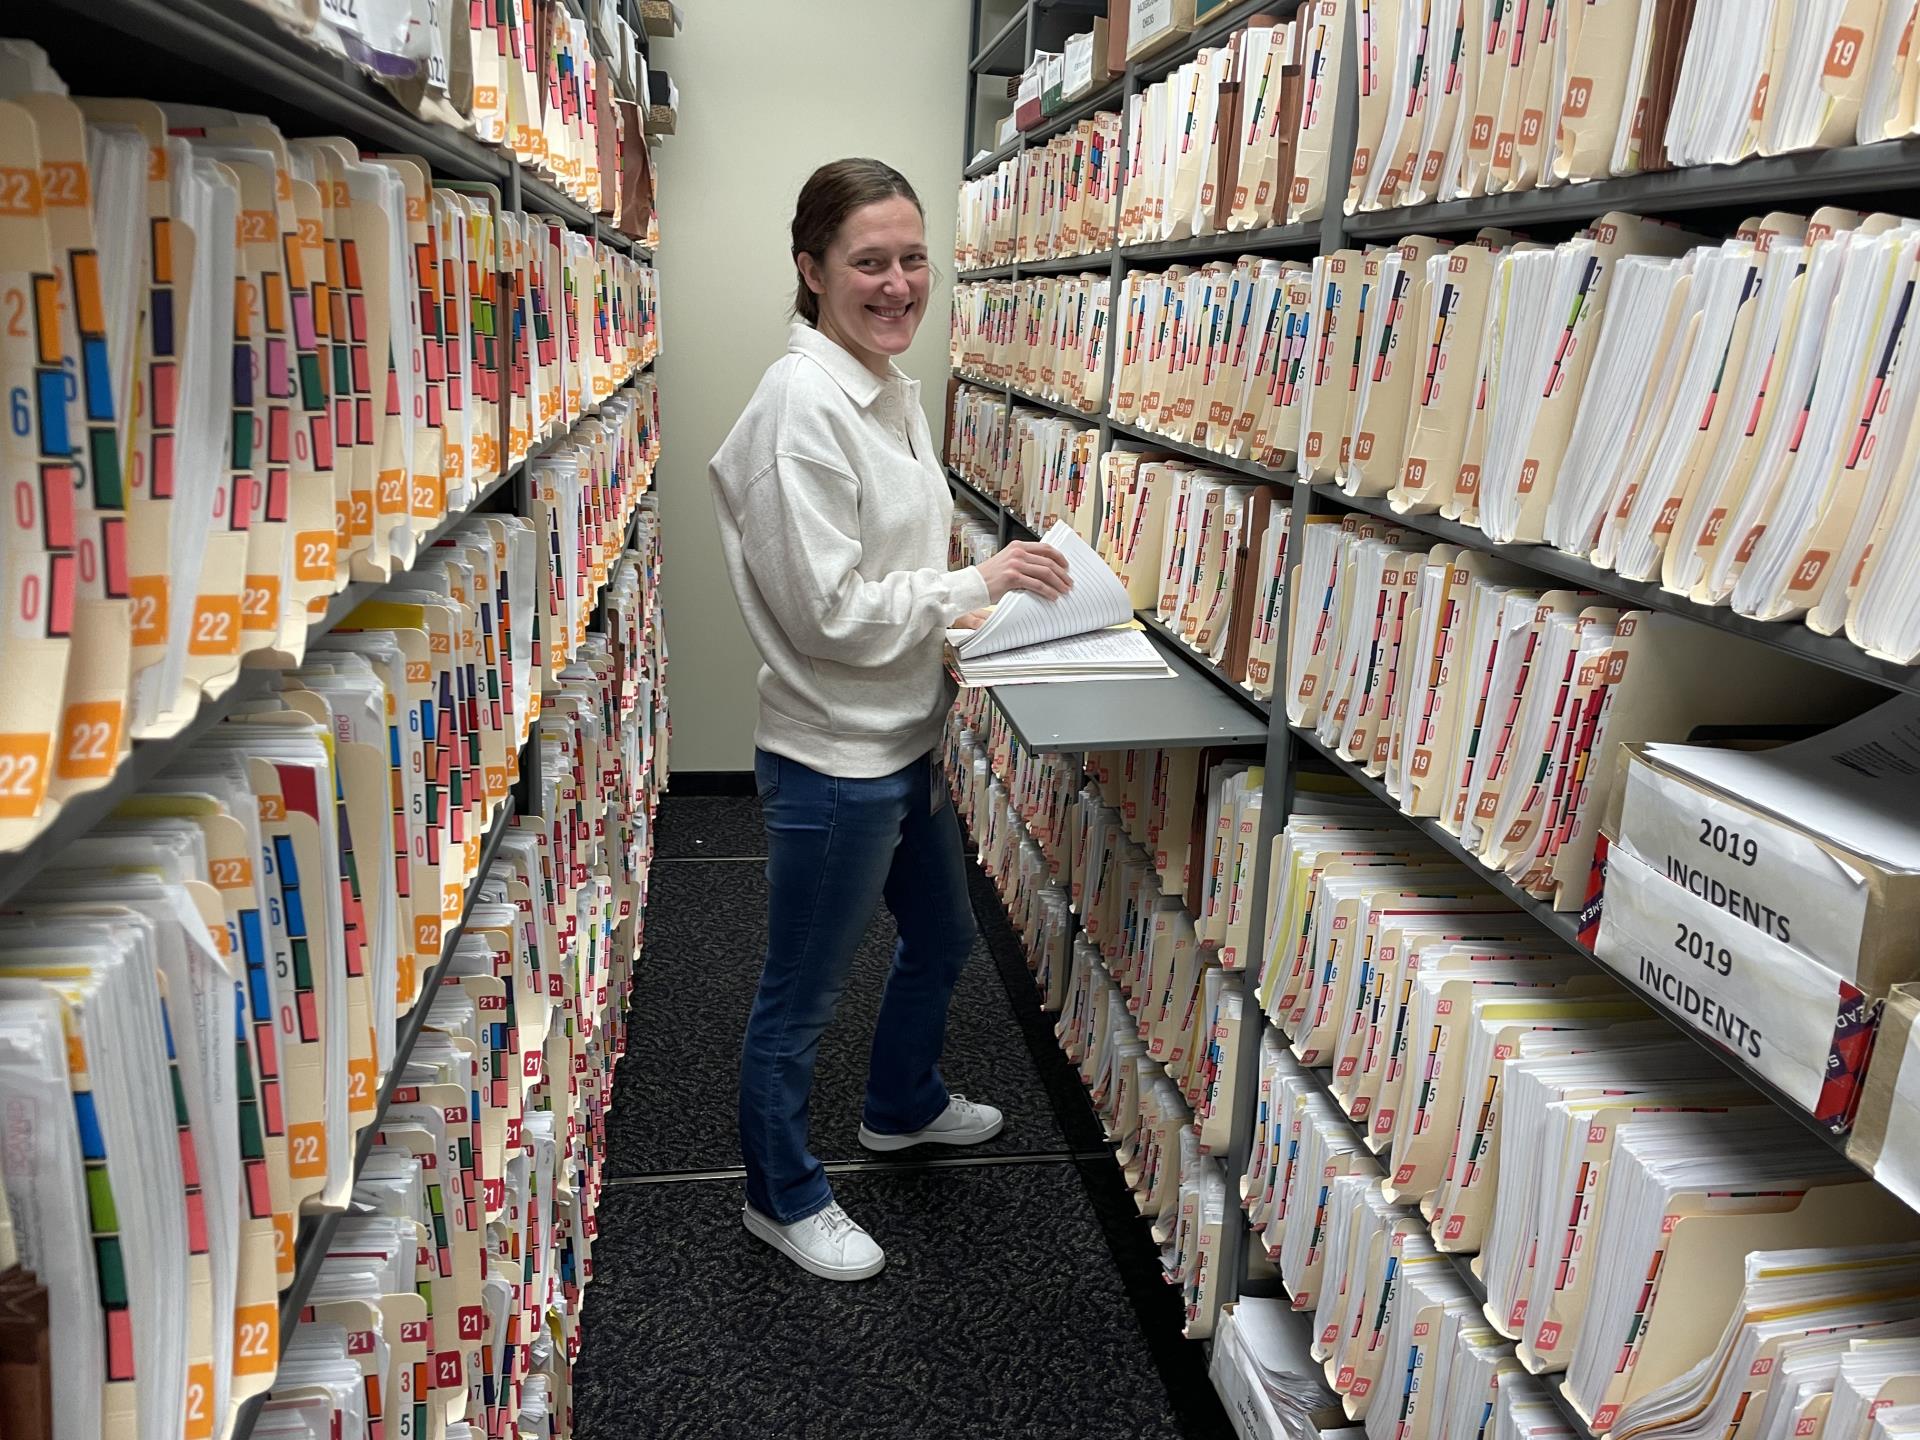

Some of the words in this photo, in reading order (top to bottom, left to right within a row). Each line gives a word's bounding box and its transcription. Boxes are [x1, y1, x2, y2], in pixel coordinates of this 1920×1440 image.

[1322, 4, 1334, 14] 19
[1272, 33, 1282, 43] 19
[1834, 39, 1855, 66] 19
[480, 91, 495, 103] 22
[1570, 87, 1586, 107] 19
[1475, 124, 1488, 140] 19
[1524, 119, 1537, 136] 19
[1499, 142, 1511, 158] 19
[1356, 156, 1366, 169] 19
[1426, 160, 1439, 173] 19
[43, 167, 80, 199] 22
[1384, 176, 1395, 189] 19
[1202, 189, 1211, 200] 19
[1258, 187, 1267, 199] 19
[1295, 185, 1306, 196] 19
[1235, 193, 1245, 204] 19
[1600, 228, 1613, 243] 19
[1404, 248, 1414, 258] 19
[1332, 261, 1343, 272] 19
[1452, 260, 1463, 271] 19
[1217, 287, 1225, 297] 19
[1293, 293, 1304, 303] 19
[1150, 397, 1157, 405] 19
[1211, 407, 1219, 416] 19
[1221, 411, 1229, 421] 19
[1242, 418, 1251, 427] 19
[1196, 427, 1204, 437] 19
[1257, 434, 1265, 444] 19
[1309, 438, 1319, 451] 19
[1360, 439, 1370, 453] 19
[1272, 454, 1282, 464] 19
[1409, 465, 1421, 480] 19
[1462, 471, 1475, 486] 19
[1523, 467, 1534, 483] 19
[380, 481, 402, 503] 22
[414, 487, 434, 509] 22
[1209, 494, 1216, 503] 19
[1227, 515, 1235, 524] 19
[1662, 506, 1675, 525] 19
[1344, 519, 1354, 529] 19
[1707, 518, 1722, 537] 19
[303, 543, 330, 568] 22
[1455, 571, 1466, 581] 19
[1802, 561, 1820, 580] 19
[1385, 573, 1396, 583] 19
[1406, 573, 1416, 583] 19
[242, 589, 270, 615] 22
[1536, 607, 1548, 620] 19
[197, 612, 231, 641] 22
[1187, 621, 1195, 632] 19
[1619, 622, 1632, 636] 19
[430, 636, 447, 650] 22
[1199, 632, 1208, 642] 19
[552, 651, 561, 663] 22
[407, 663, 425, 680] 22
[1258, 668, 1268, 680] 19
[1608, 660, 1623, 676] 19
[1582, 669, 1594, 682] 19
[1303, 680, 1313, 690] 19
[69, 721, 111, 761] 22
[1352, 733, 1361, 744] 19
[1377, 742, 1388, 754] 19
[1414, 756, 1428, 769] 19
[489, 773, 503, 789] 22
[605, 773, 612, 784] 21
[563, 789, 573, 799] 21
[1480, 797, 1494, 812] 19
[1513, 824, 1525, 838] 19
[1699, 818, 1758, 866] 2019
[212, 862, 243, 884] 22
[443, 893, 458, 911] 22
[1667, 854, 1790, 944] INCIDENTS
[1580, 899, 1604, 922] SMEA
[1333, 920, 1345, 929] 20
[420, 925, 438, 943] 22
[1381, 949, 1392, 959] 20
[1674, 923, 1732, 977] 2019
[1224, 953, 1234, 963] 20
[551, 980, 560, 991] 21
[480, 998, 494, 1008] 21
[1438, 1002, 1450, 1011] 20
[1639, 956, 1762, 1059] INCIDENTS
[1497, 1046, 1510, 1057] 20
[527, 1058, 539, 1070] 21
[1341, 1061, 1353, 1071] 20
[1353, 1103, 1365, 1113] 20
[446, 1110, 462, 1121] 21
[1377, 1115, 1390, 1129] 20
[507, 1127, 518, 1140] 21
[1589, 1128, 1604, 1142] 20
[293, 1136, 320, 1164] 22
[1397, 1168, 1410, 1180] 20
[484, 1188, 494, 1202] 21
[1446, 1220, 1460, 1233] 20
[463, 1316, 478, 1331] 21
[1415, 1324, 1427, 1334] 20
[402, 1324, 421, 1338] 21
[1325, 1329, 1336, 1338] 20
[1540, 1328, 1557, 1343] 20
[239, 1322, 269, 1357] 22
[349, 1333, 368, 1349] 21
[441, 1363, 456, 1378] 21
[1753, 1361, 1770, 1373] 20
[1339, 1372, 1350, 1383] 20
[1355, 1381, 1367, 1391] 20
[1600, 1409, 1614, 1423] 20
[1800, 1420, 1815, 1434] 20
